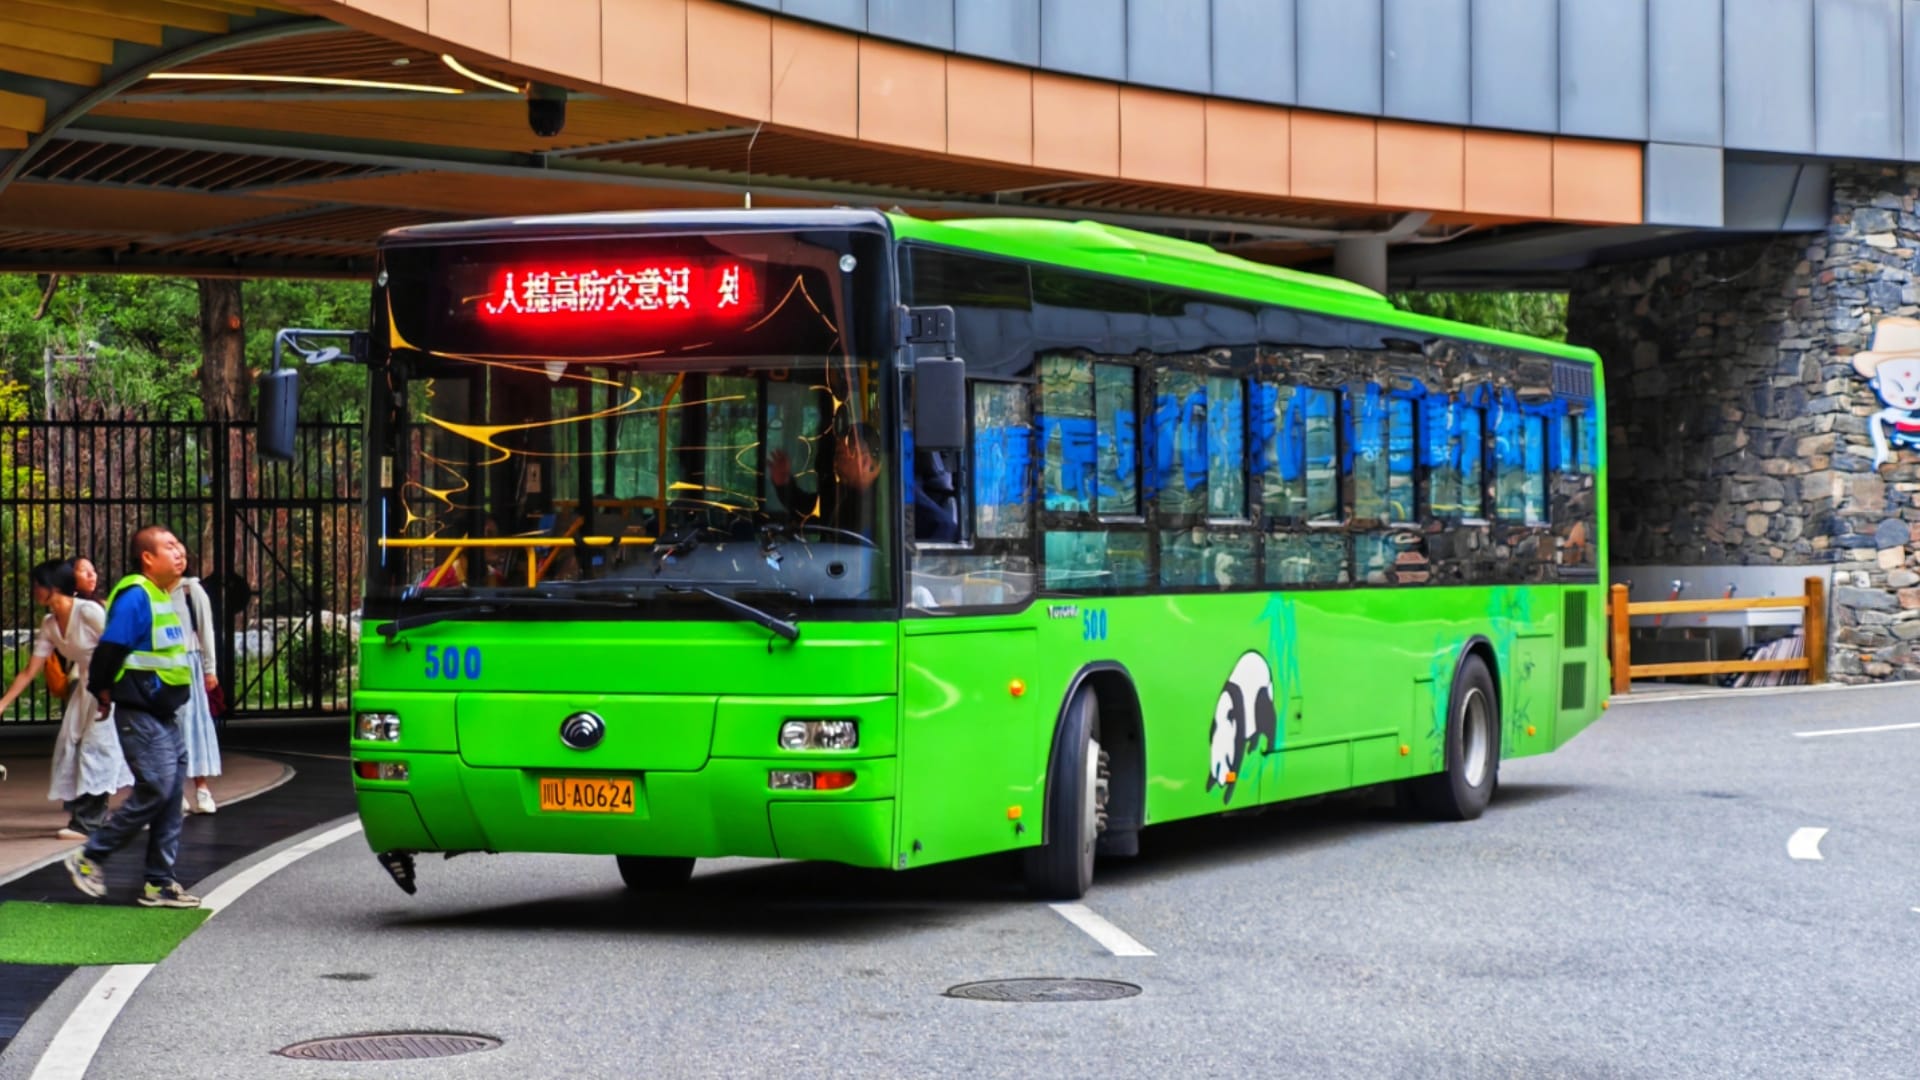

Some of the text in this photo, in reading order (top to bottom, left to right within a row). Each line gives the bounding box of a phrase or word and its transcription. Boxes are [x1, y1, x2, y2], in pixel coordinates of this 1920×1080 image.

[485, 267, 691, 314] 人提高防灾意识
[1083, 607, 1107, 641] 500
[424, 644, 482, 680] 500
